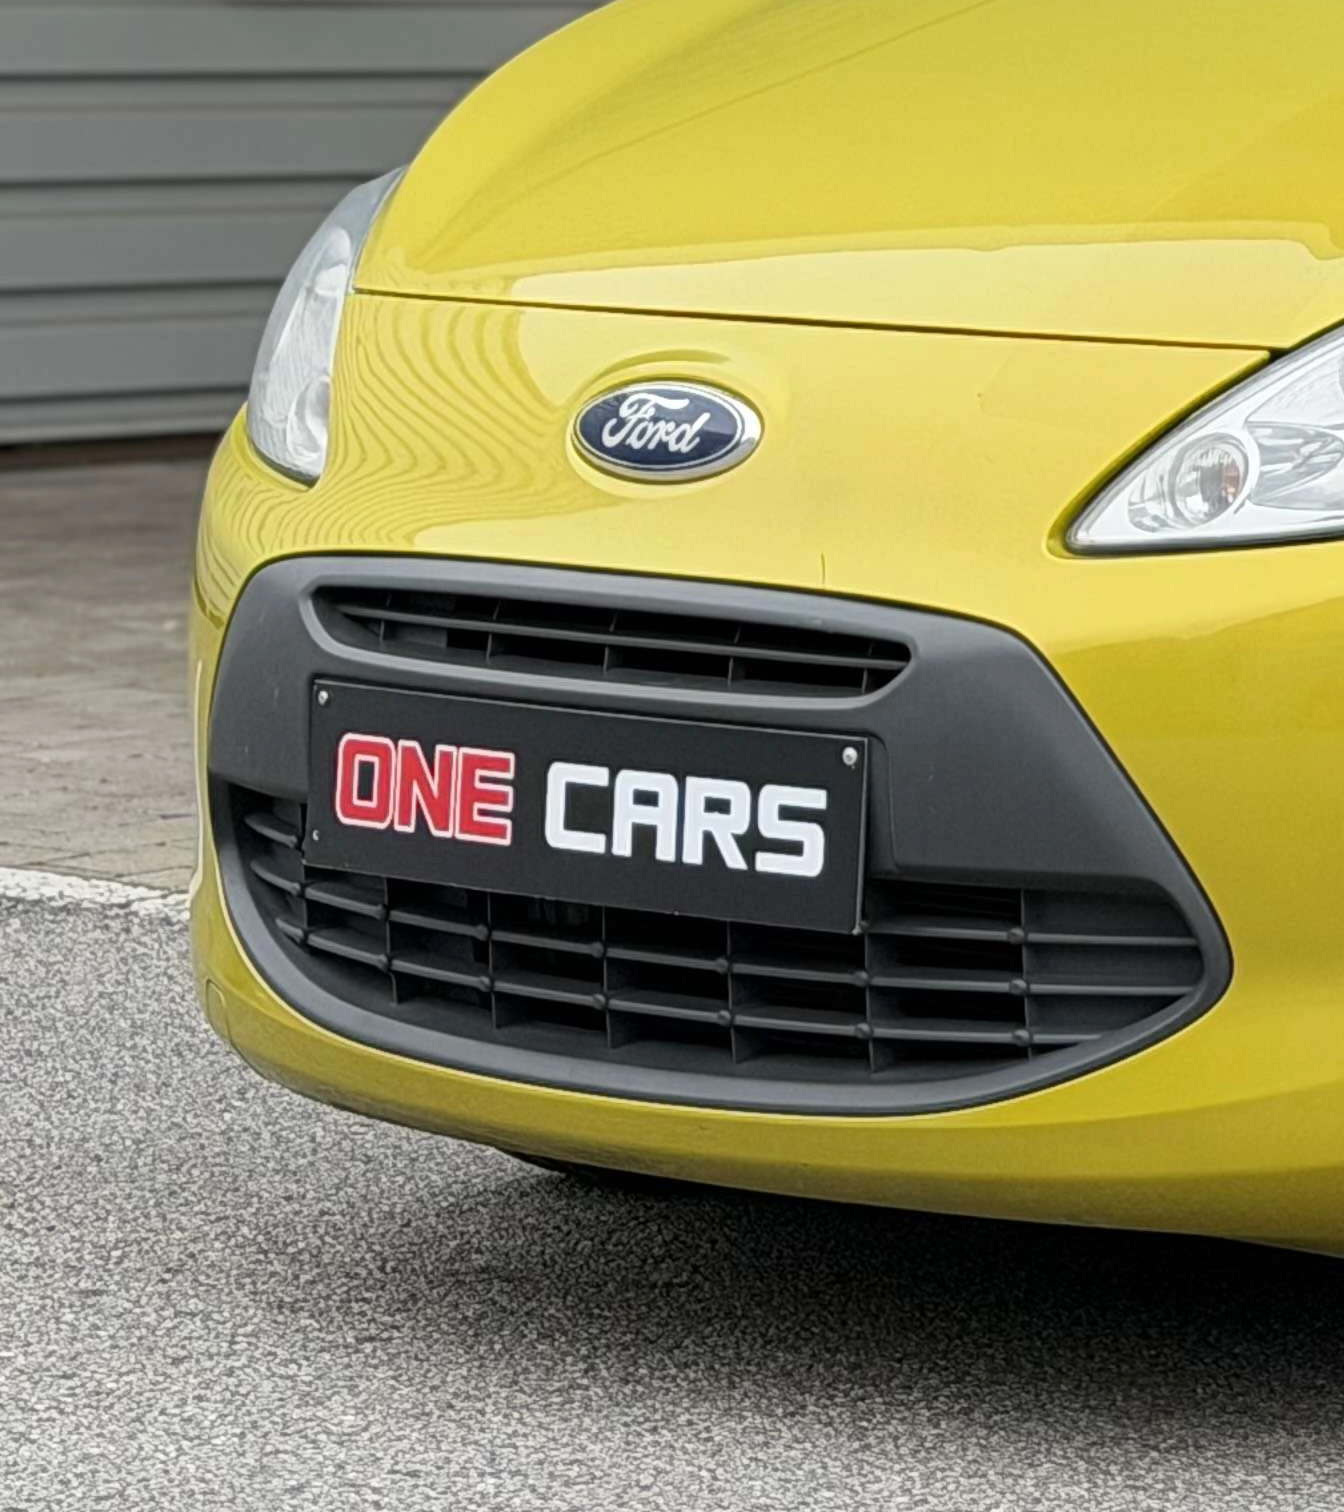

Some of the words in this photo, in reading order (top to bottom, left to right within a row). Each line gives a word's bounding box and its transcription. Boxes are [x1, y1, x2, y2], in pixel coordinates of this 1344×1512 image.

[601, 392, 711, 454] Ford
[335, 731, 516, 846] ONE
[544, 761, 828, 878] CARS
